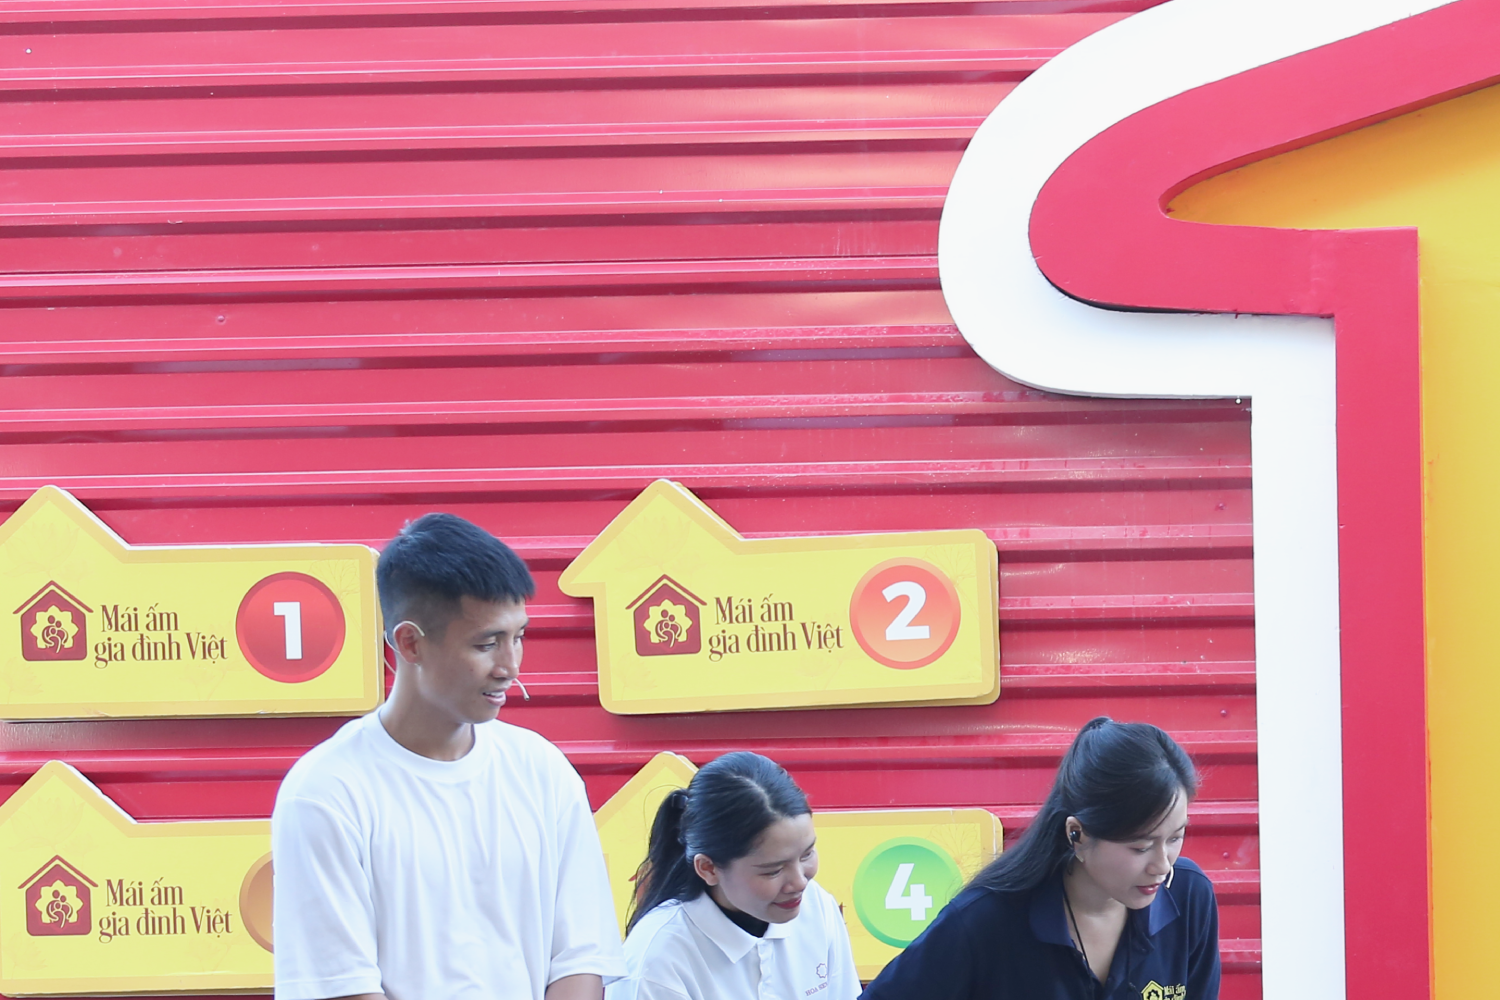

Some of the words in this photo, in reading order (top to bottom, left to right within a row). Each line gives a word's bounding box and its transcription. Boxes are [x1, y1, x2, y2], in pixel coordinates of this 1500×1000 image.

[100, 604, 139, 632] Mái
[145, 602, 179, 632] ấm
[714, 596, 754, 625] Mái
[760, 593, 794, 623] ấm
[881, 580, 931, 641] 2
[273, 601, 303, 660] 1
[708, 629, 741, 662] gia
[746, 623, 798, 653] đình
[800, 621, 845, 653] Việt
[94, 637, 126, 669] gia
[131, 633, 182, 662] đình
[185, 632, 229, 664] Việt
[105, 878, 144, 907] Mái
[150, 876, 184, 906] ấm
[885, 863, 933, 921] 4
[98, 911, 130, 944] gia
[136, 907, 187, 936] đình
[189, 906, 233, 938] Việt
